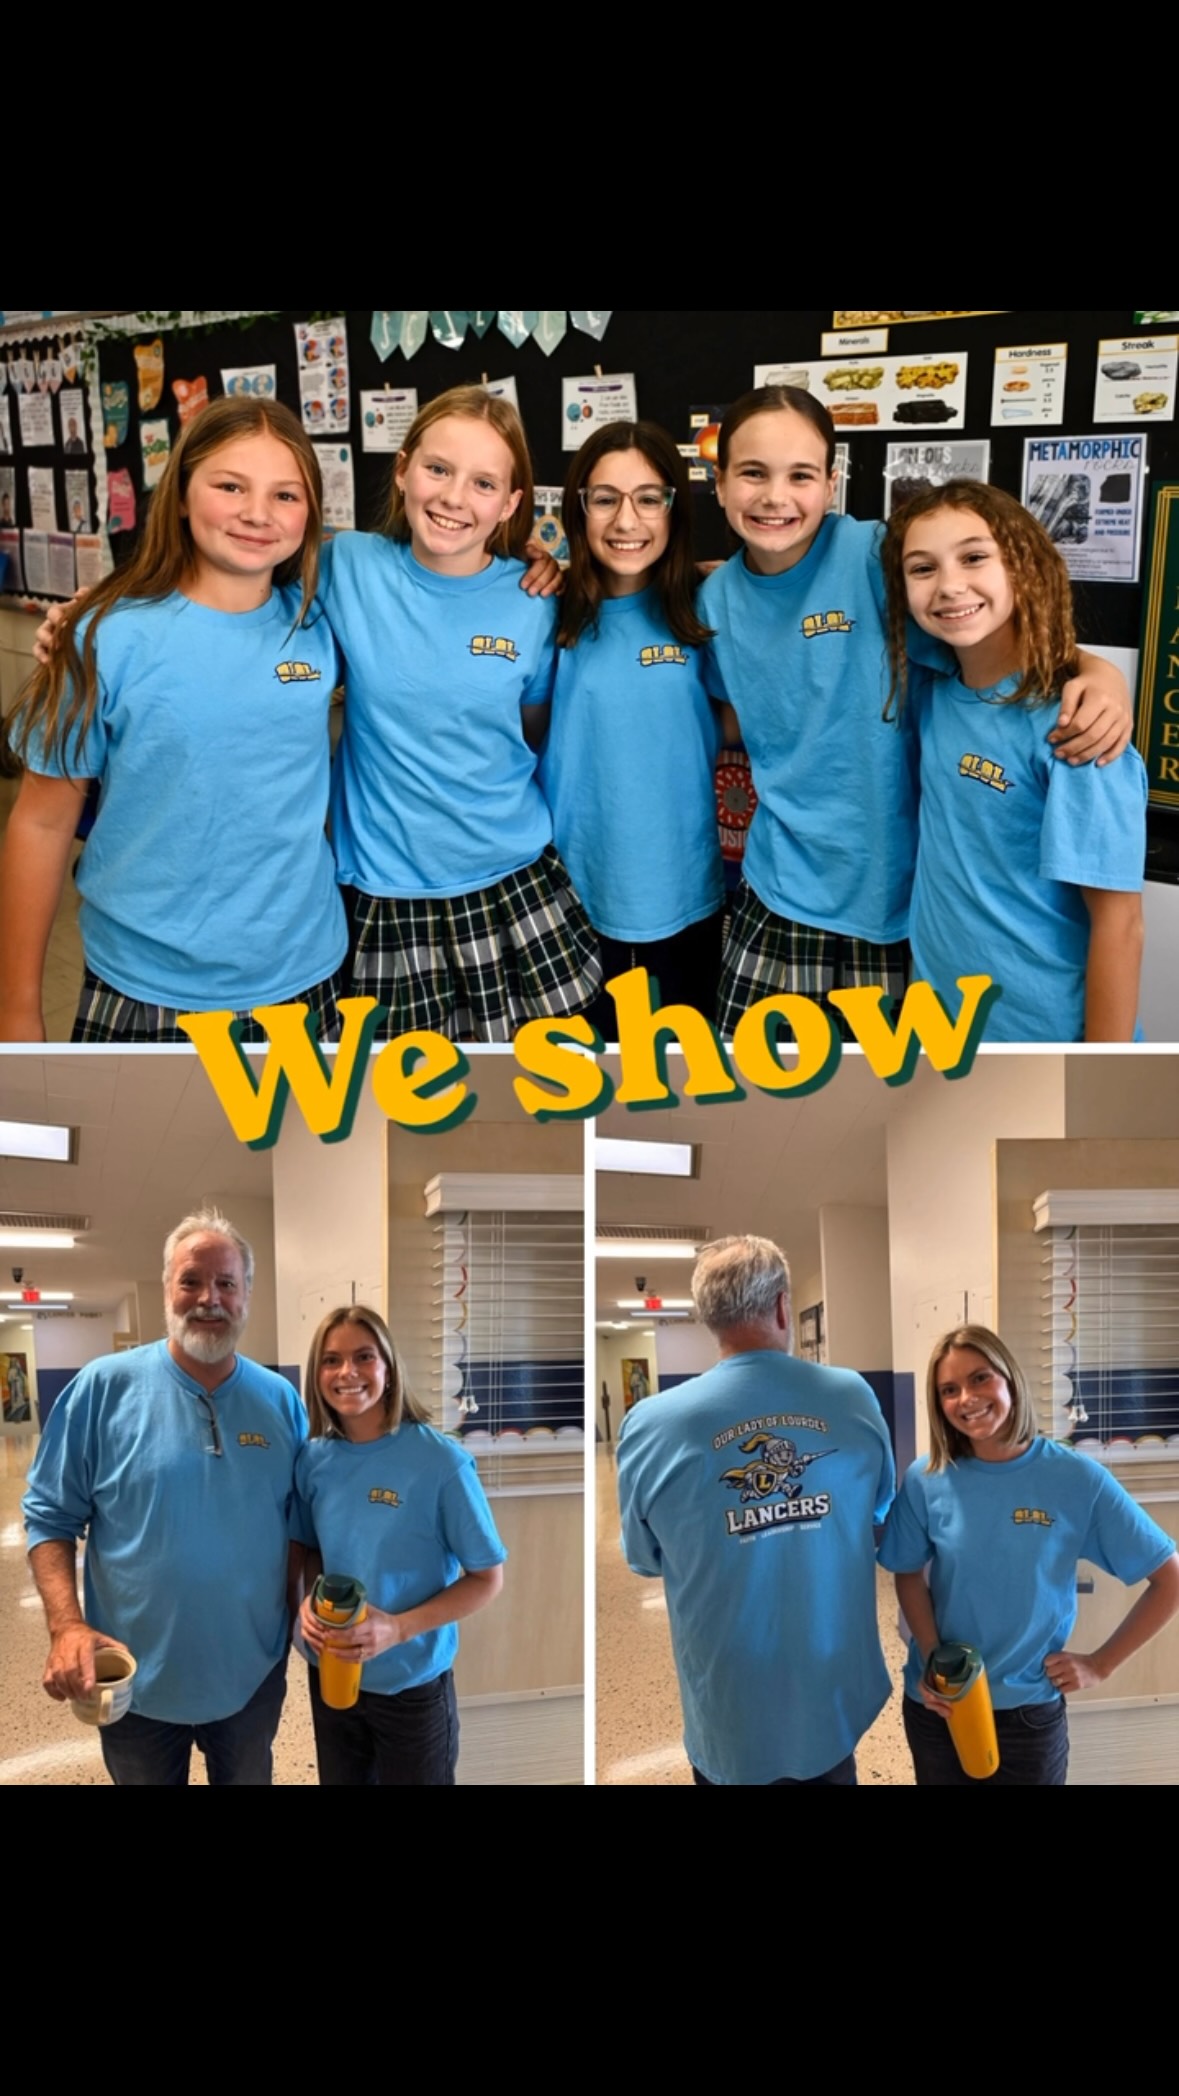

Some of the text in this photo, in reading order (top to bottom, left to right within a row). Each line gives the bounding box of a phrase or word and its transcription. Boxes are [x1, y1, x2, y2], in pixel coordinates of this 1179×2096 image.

[839, 337, 870, 346] Minerals
[1121, 339, 1155, 351] Streak
[1008, 348, 1053, 359] Hardness
[1030, 439, 1141, 461] METAMORPHIC
[712, 1414, 830, 1451] OUR LADY OF LOURDES
[759, 1474, 771, 1490] L
[726, 1493, 831, 1535] LANCERS
